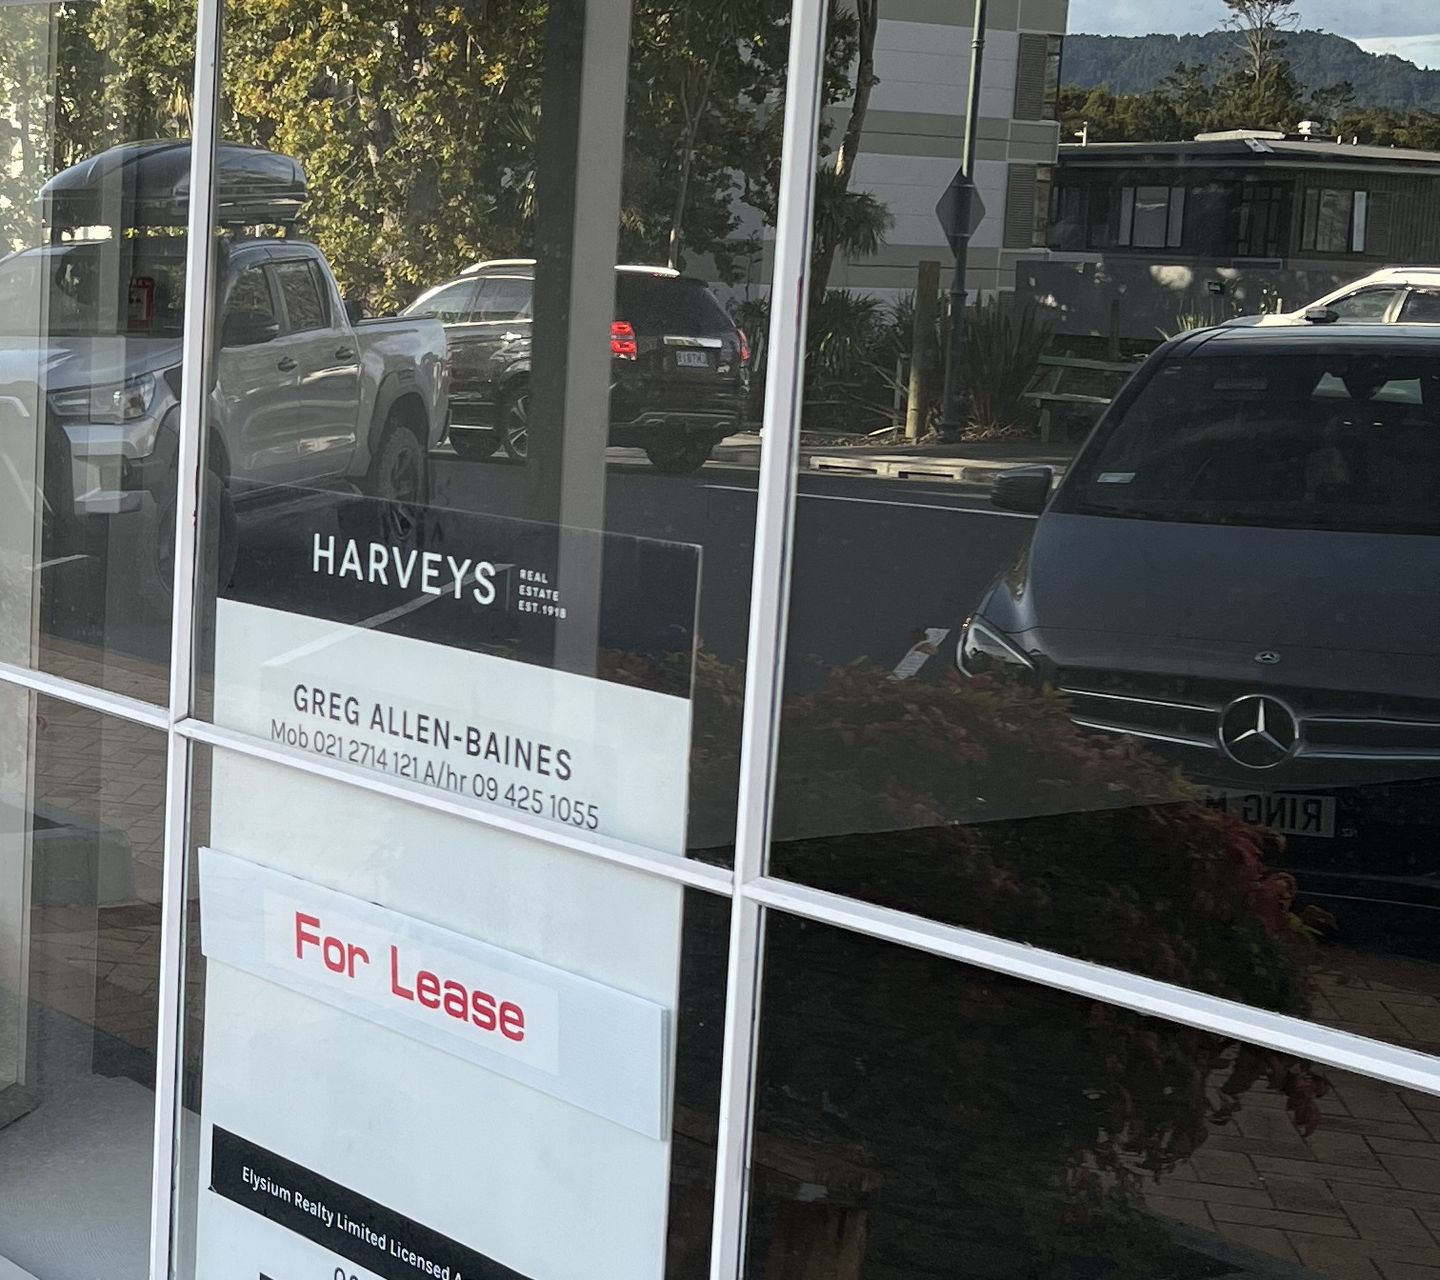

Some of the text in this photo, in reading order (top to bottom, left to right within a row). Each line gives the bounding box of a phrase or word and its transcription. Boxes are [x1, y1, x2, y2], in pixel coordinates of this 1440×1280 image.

[312, 532, 496, 605] HARVEYS
[519, 569, 548, 584] REAL
[519, 585, 559, 601] ESTATE
[518, 600, 567, 619] EST.1918
[293, 683, 572, 781] GREG ALLEN-BAINES
[270, 718, 599, 830] Mob 021 2714 121 A/hr 09 425 1055
[295, 911, 526, 1042] For Lease
[242, 1166, 292, 1204] Elysium
[294, 1191, 334, 1228] Realty
[336, 1212, 386, 1251] Limited
